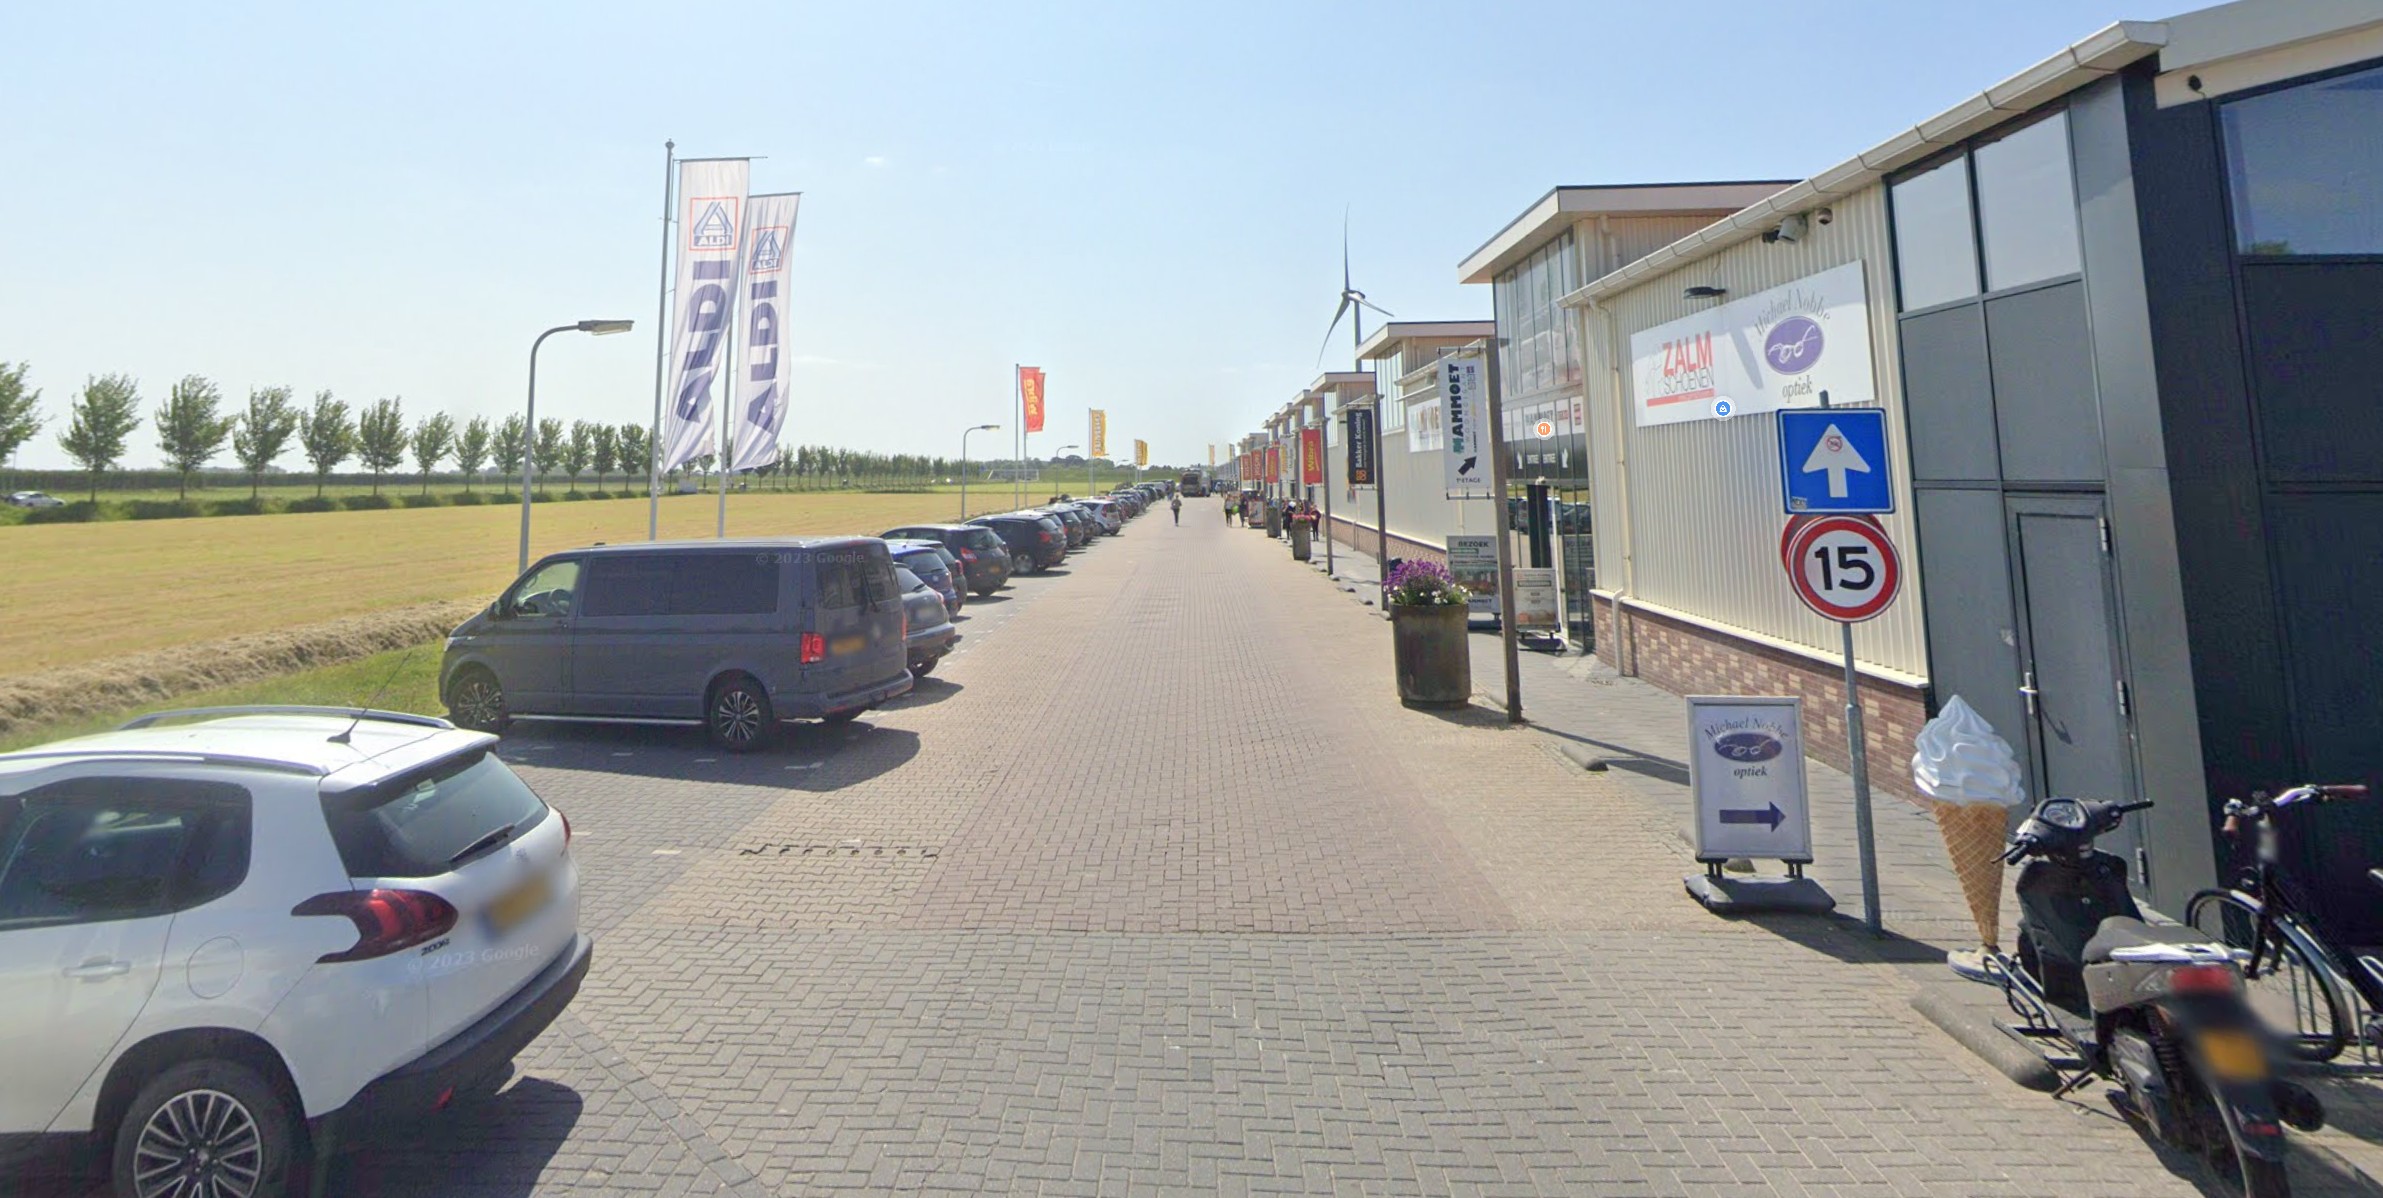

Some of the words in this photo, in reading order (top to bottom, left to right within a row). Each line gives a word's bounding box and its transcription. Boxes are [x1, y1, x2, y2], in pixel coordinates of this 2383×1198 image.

[697, 235, 732, 246] ALDI
[753, 258, 779, 270] ALDI
[1754, 288, 1792, 337] Michael
[677, 260, 731, 423] ALDI
[1662, 331, 1713, 377] ZALM
[747, 280, 779, 435] ALDI
[1664, 367, 1714, 395] SCHOENEN
[1782, 375, 1813, 403] optiek
[1448, 364, 1465, 454] MAMMOET
[1354, 412, 1363, 440] Koning
[1354, 441, 1363, 468] Bakker
[1814, 546, 1875, 590] 15
[1704, 717, 1749, 740] Michael
[1752, 717, 1789, 738] Nobbe
[1733, 765, 1768, 780] optiek
